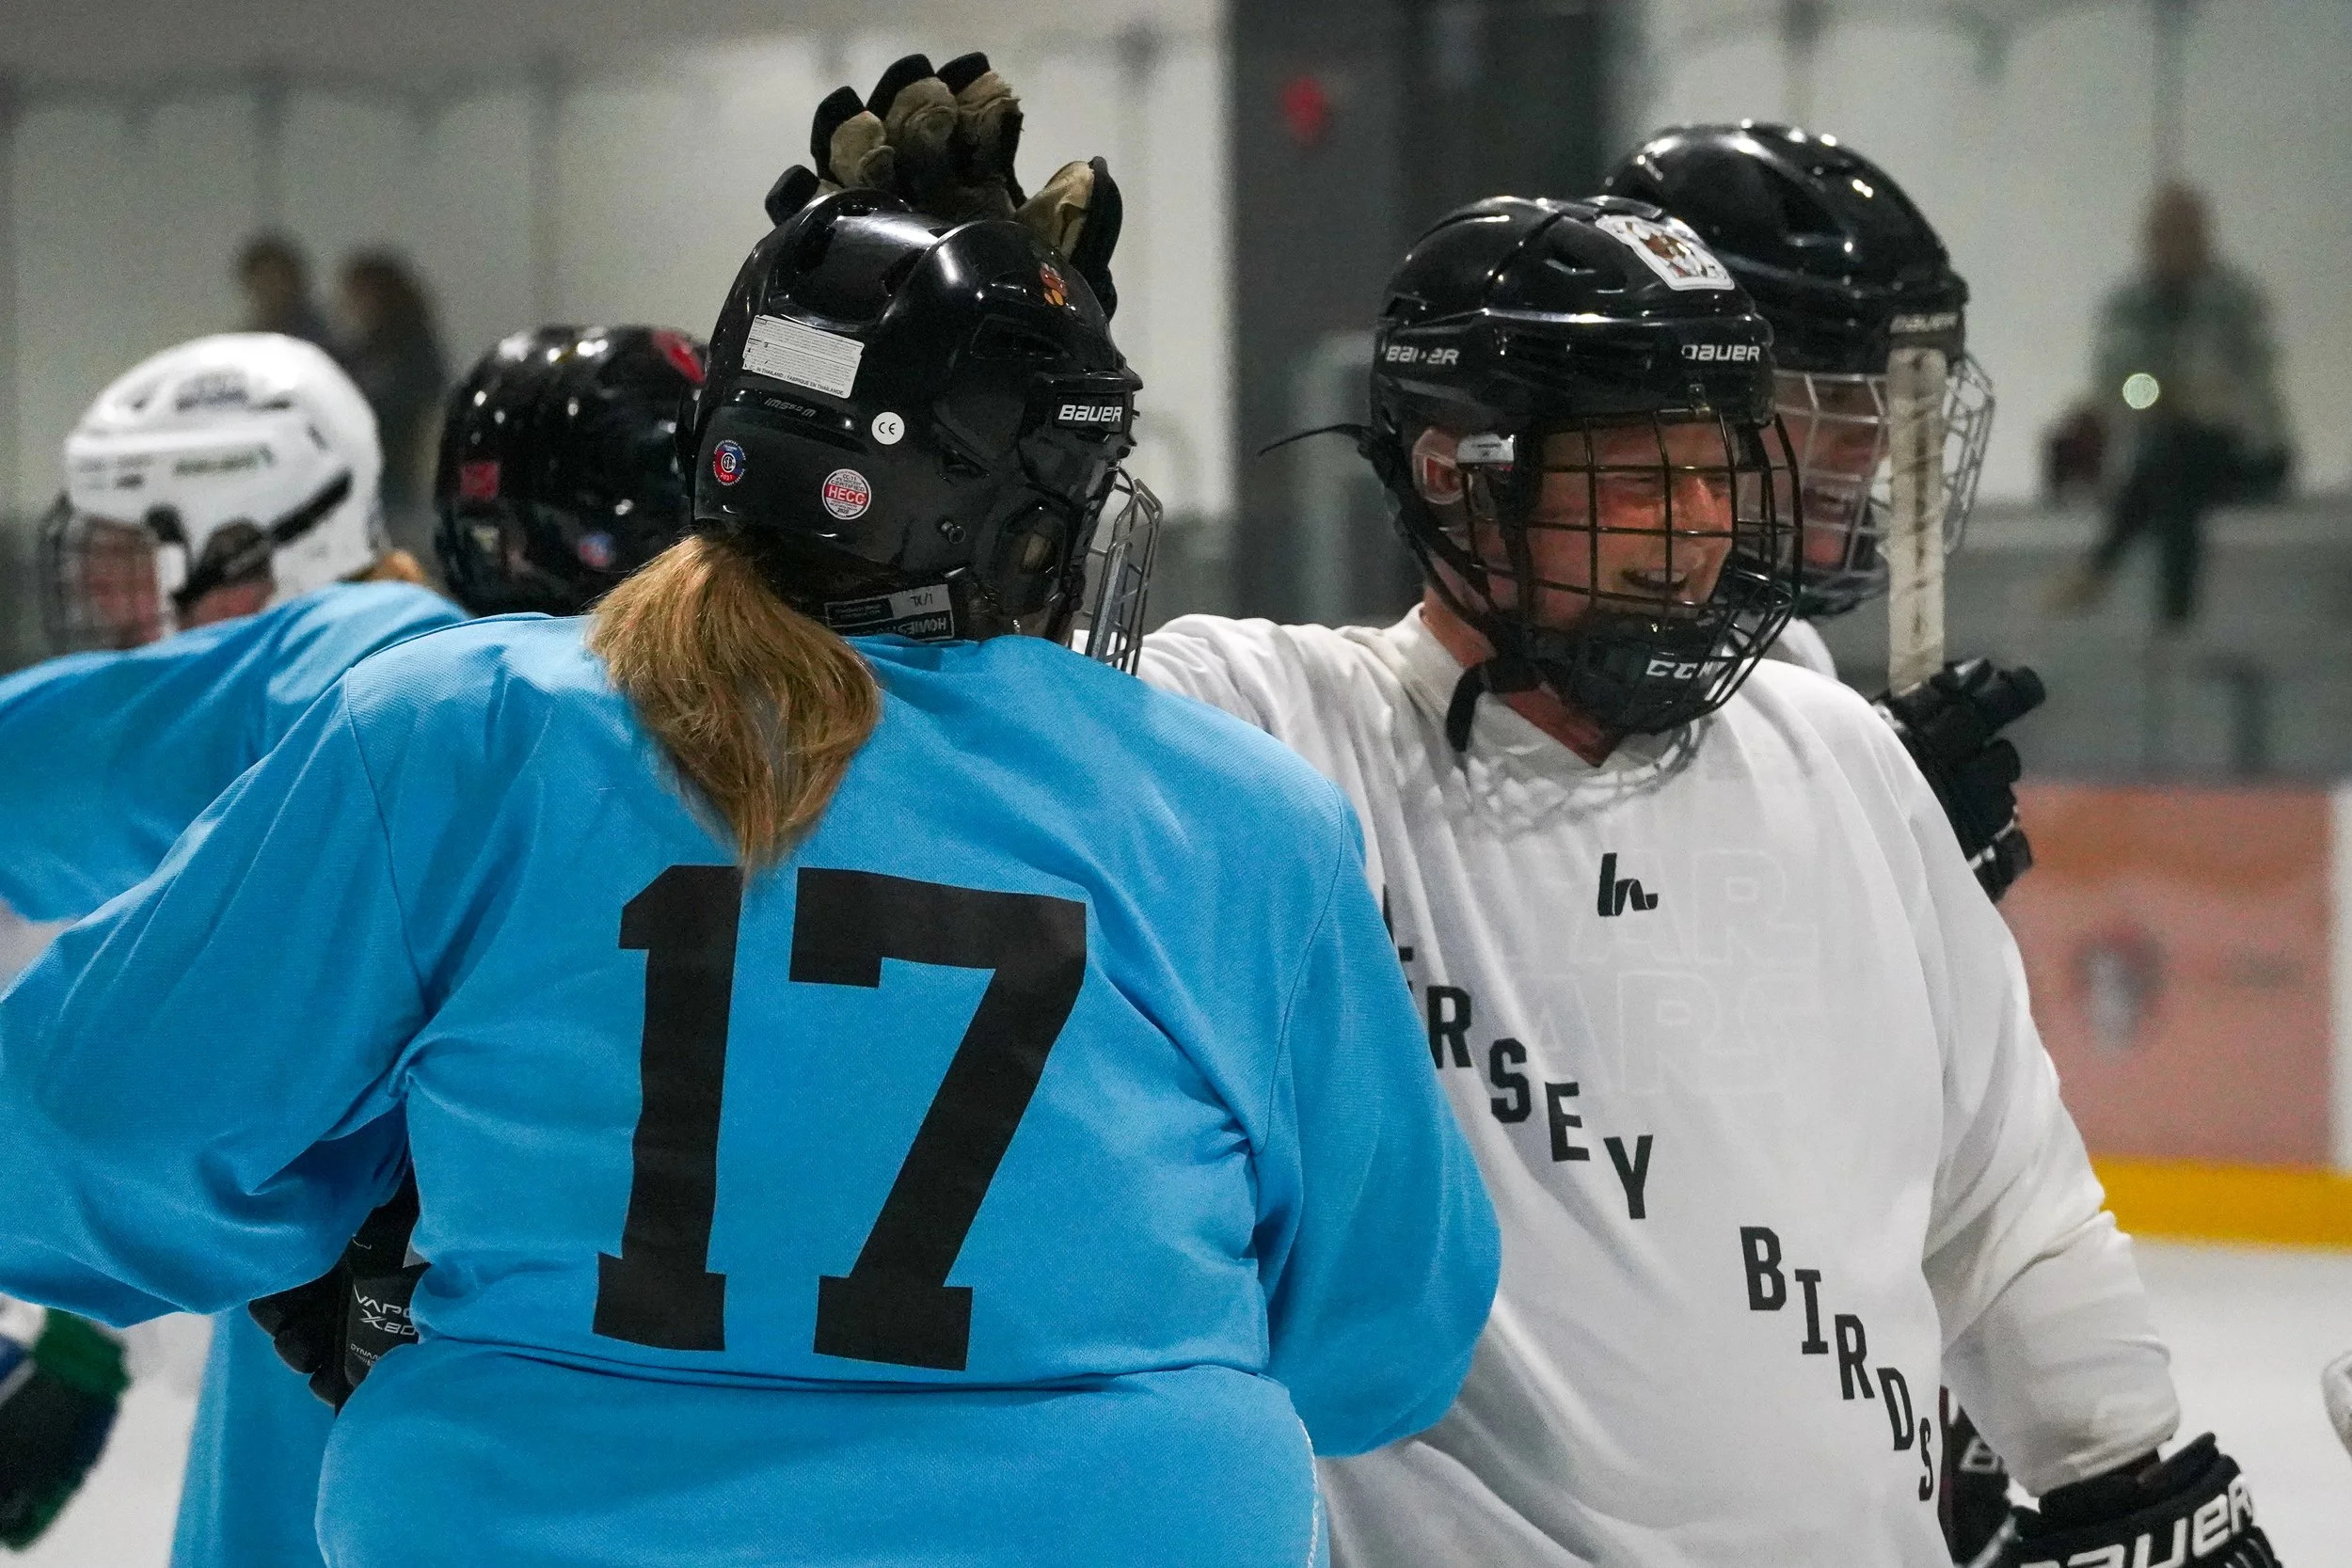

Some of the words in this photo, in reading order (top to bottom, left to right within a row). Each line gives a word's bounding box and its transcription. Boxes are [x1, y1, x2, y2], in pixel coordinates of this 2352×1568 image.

[878, 421, 897, 436] CE
[1058, 404, 1122, 422] BAUER
[828, 485, 866, 505] HECC
[593, 864, 1088, 1371] 17
[1382, 884, 1653, 1220] RSEY
[1740, 1226, 1934, 1502] BIRDS
[2019, 1473, 2254, 1568] UER
